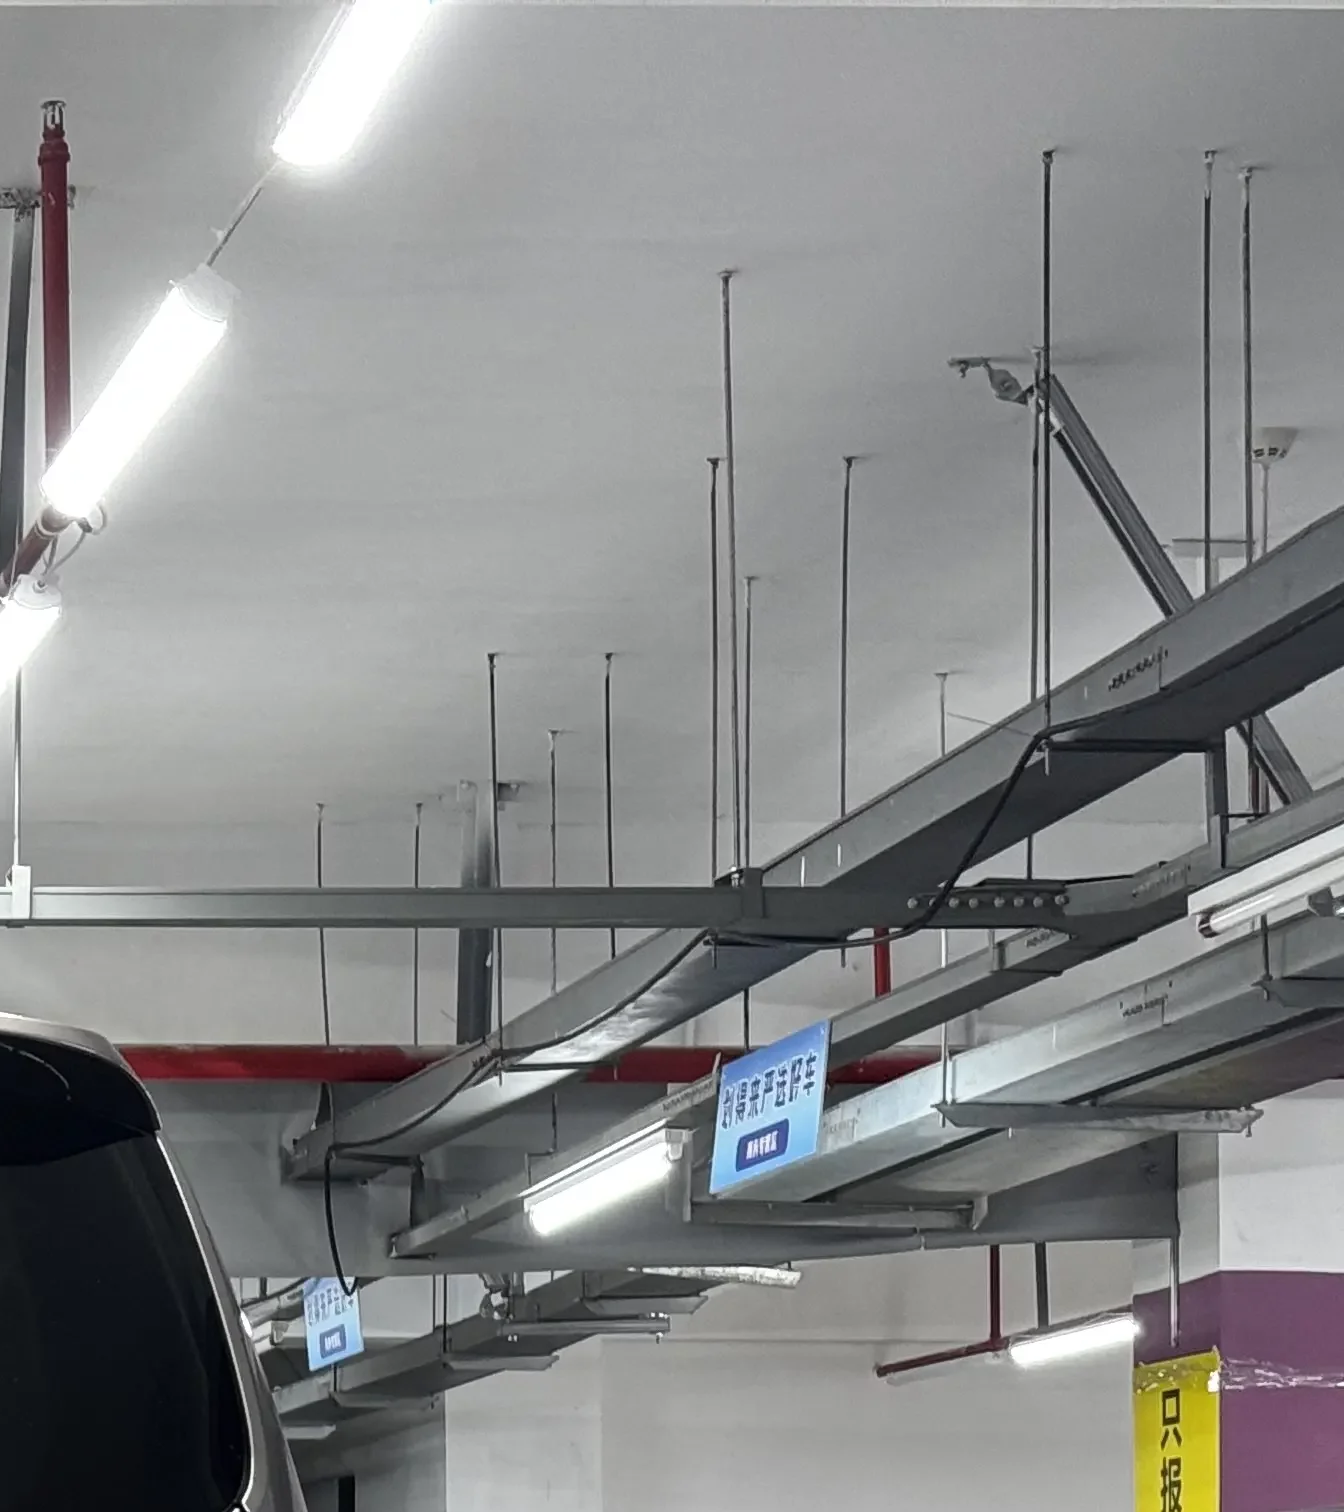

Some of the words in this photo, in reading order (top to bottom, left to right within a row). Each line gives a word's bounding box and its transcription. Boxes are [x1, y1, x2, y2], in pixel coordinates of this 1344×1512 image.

[721, 1051, 818, 1130] 划得来严选好车
